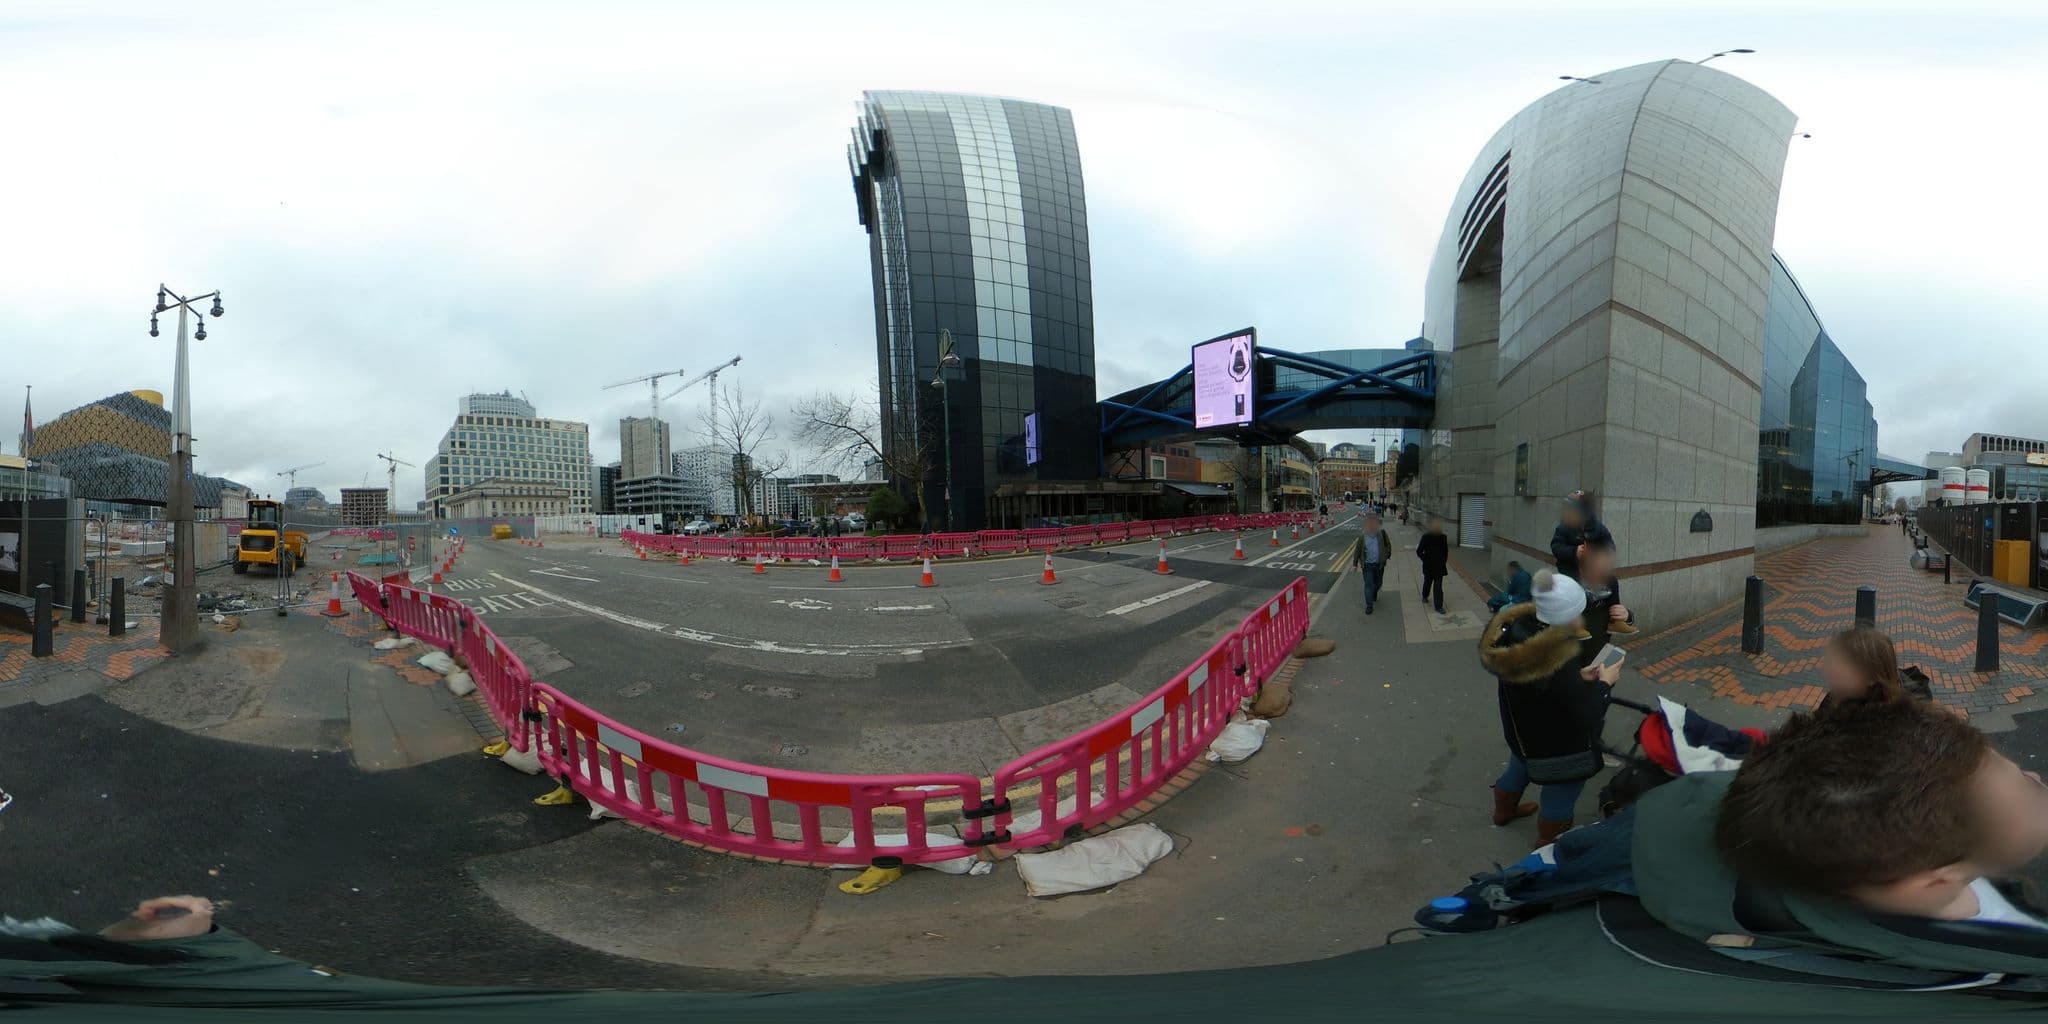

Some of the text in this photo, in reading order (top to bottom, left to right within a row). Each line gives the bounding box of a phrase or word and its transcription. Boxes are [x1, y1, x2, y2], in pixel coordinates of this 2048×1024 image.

[1279, 550, 1339, 561] LANE
[1266, 561, 1317, 572] BUS
[444, 579, 496, 592] BUS
[458, 591, 557, 615] GATE
